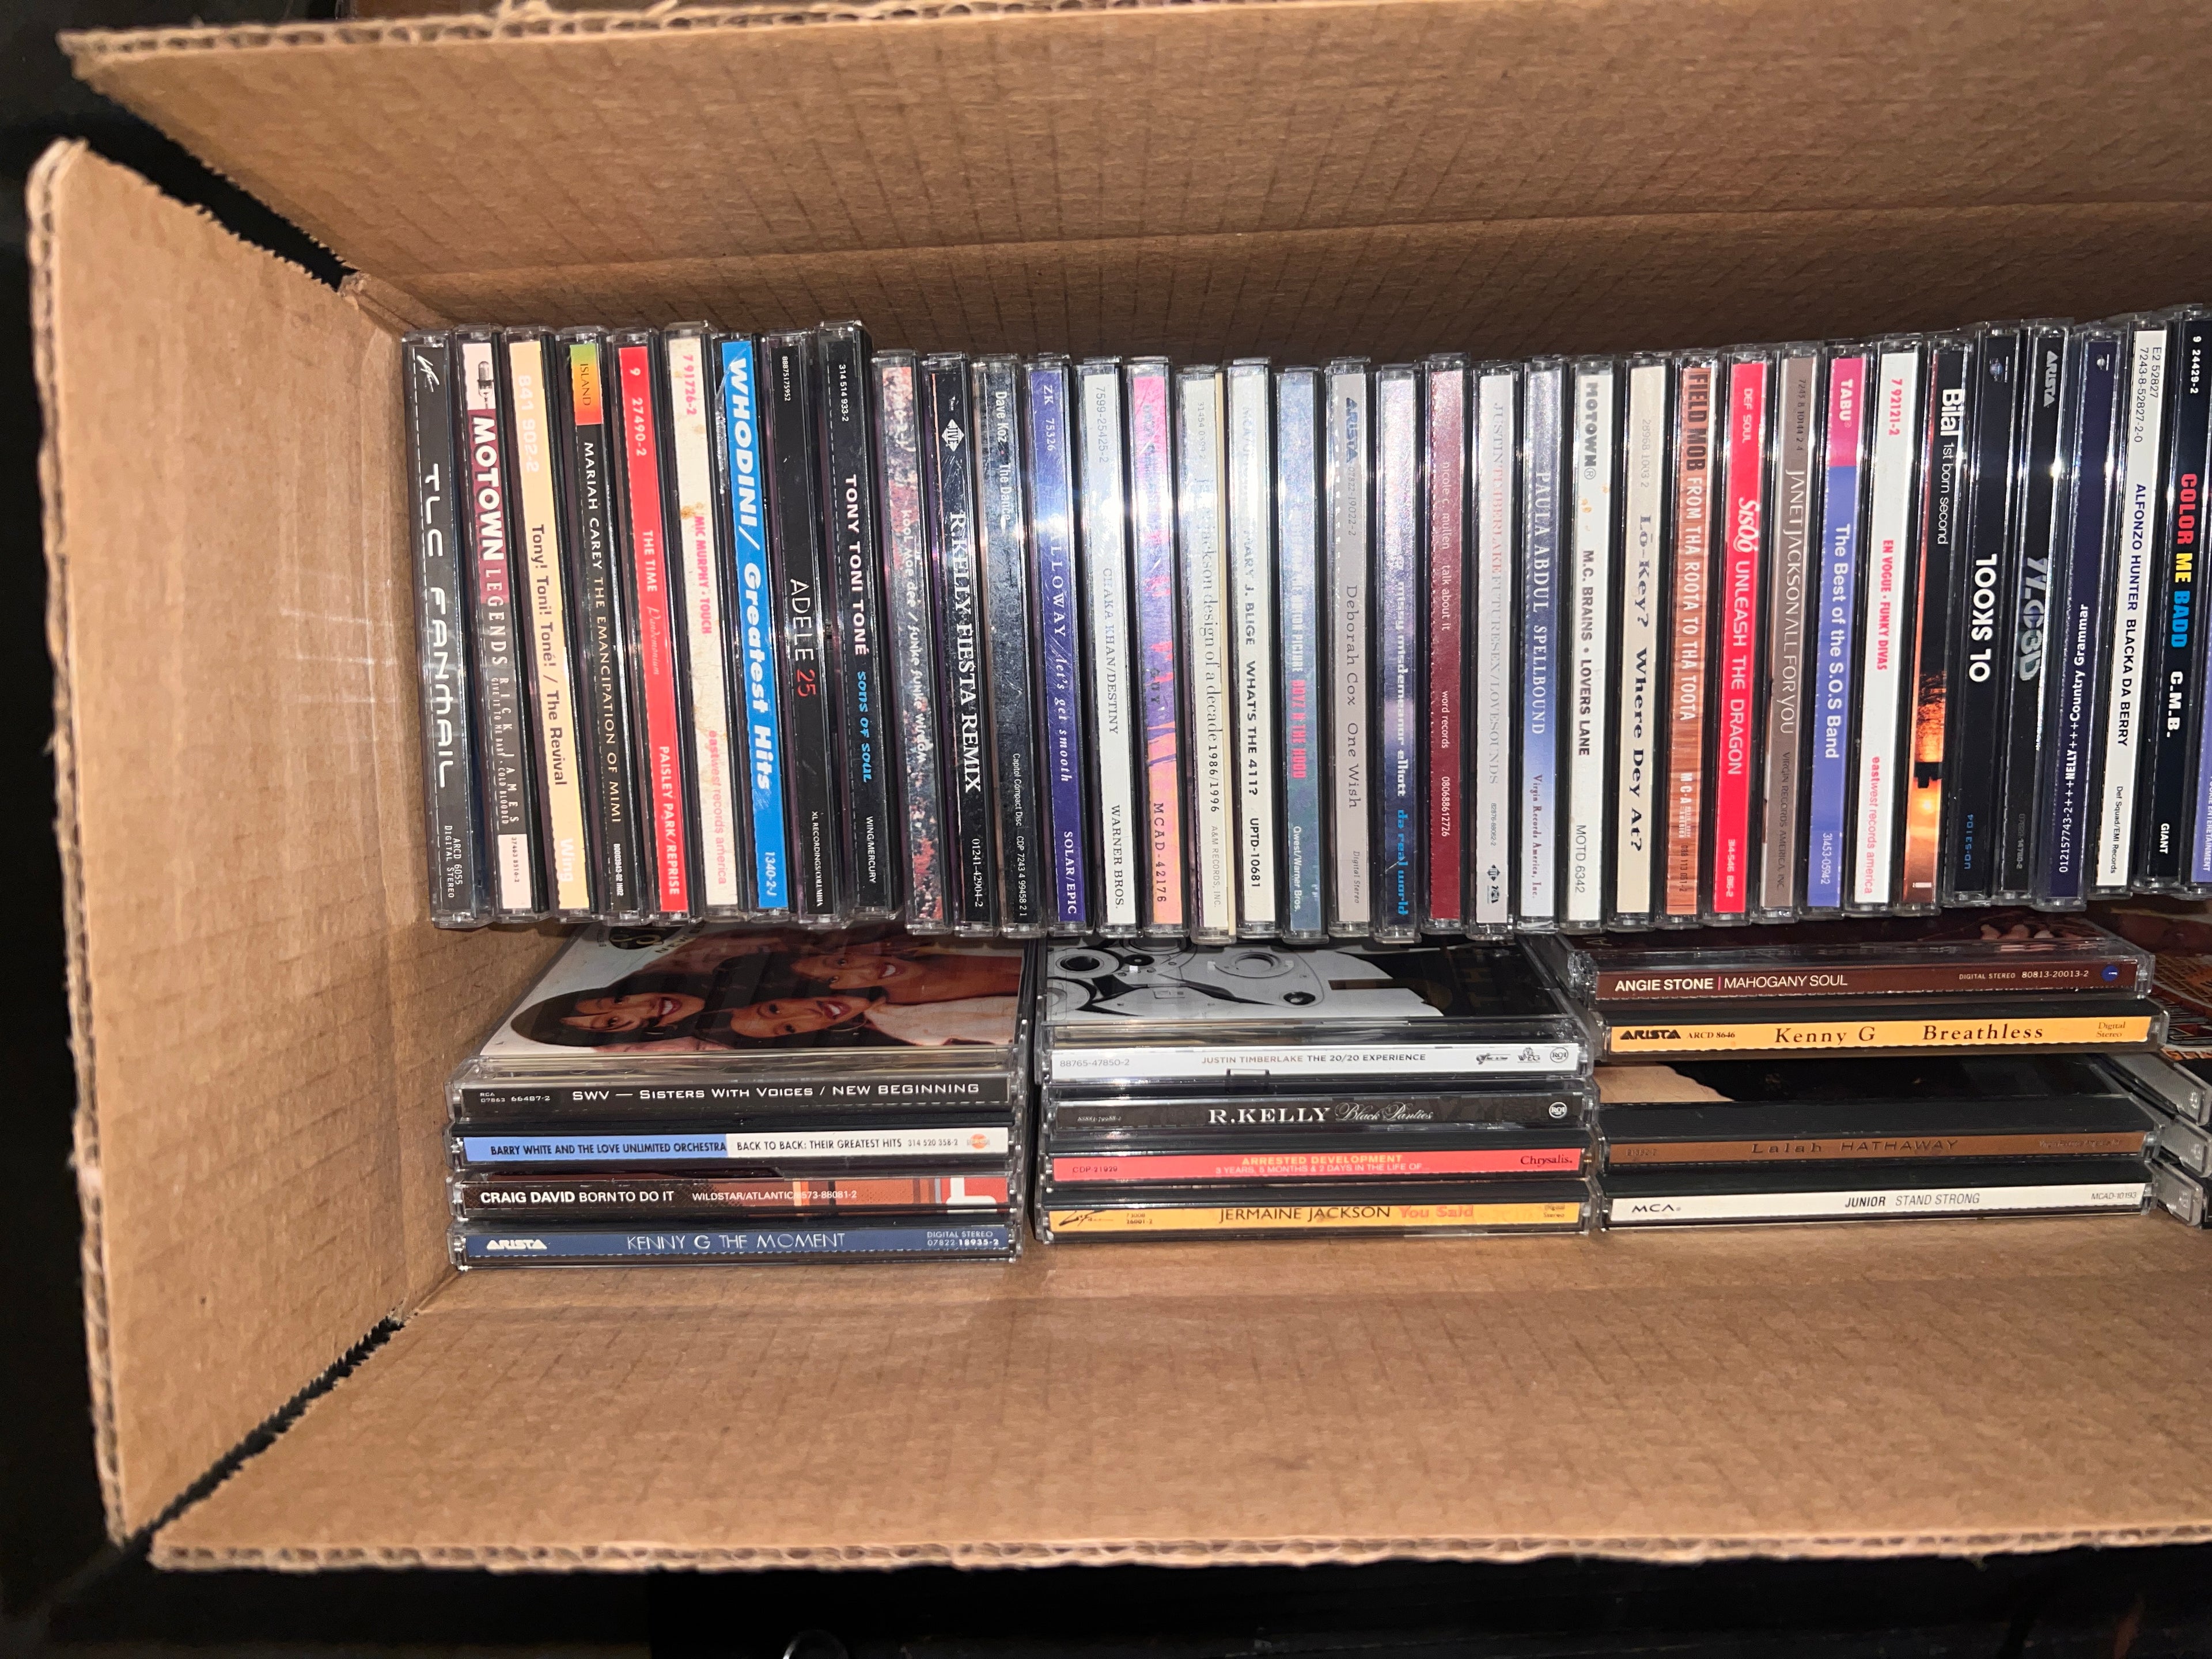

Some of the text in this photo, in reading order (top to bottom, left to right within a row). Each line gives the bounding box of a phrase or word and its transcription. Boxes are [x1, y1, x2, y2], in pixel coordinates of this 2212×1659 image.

[839, 364, 847, 380] 314
[2043, 350, 2058, 408] ARISTA
[2153, 347, 2162, 362] E2
[518, 375, 533, 411] 841
[579, 363, 592, 406] ISLAND
[684, 365, 696, 415] 91726-2
[1043, 385, 1053, 405] ZK
[1889, 388, 1902, 436] 92121-2
[2134, 347, 2149, 443] 7243-8-52827-2-0
[632, 397, 647, 457] 27490-2
[995, 391, 1011, 483] Dave Koz The
[1095, 386, 1108, 463] 7599-25425-2
[1346, 397, 1358, 465] ARISTA
[1742, 388, 1753, 444] DEF SOUL
[1937, 388, 1964, 545] Bilal born second
[472, 417, 508, 665] MOTOWN LEGENDS
[1679, 373, 1708, 721] FIELD MOB FROM THA ROOTA THA TOOTA
[1883, 539, 1894, 554] EN
[695, 516, 713, 634] MIC MURPHY TOUCH
[1532, 471, 1551, 734] PAULA ABDUL SPELLBOUND
[425, 464, 454, 787] TLC FANMAIL
[583, 442, 622, 823] MARIAH CAREY THE EMANCIPATION OF MIMI
[790, 578, 814, 661] ADELE
[1395, 581, 1406, 630] missy
[2117, 483, 2146, 747] ALFONZO HUNTER BLACKA DA BERRY
[531, 524, 564, 785] Tony! Toni! The Revival
[1291, 634, 1303, 672] PICTURE
[1441, 565, 1451, 748] talk about word records
[1825, 524, 1851, 758] The Best the Band
[2073, 604, 2088, 666] Grammar
[745, 562, 774, 790] Greatest Hits
[845, 475, 877, 883] TONY TONI WING/MERCURY
[1149, 667, 1161, 705] GUY
[1244, 603, 1257, 753] BLIGE THE
[1728, 560, 1749, 775] UNLEASH DRAGON
[1782, 656, 1797, 694] FOR
[2159, 474, 2198, 854] COLOR ME BADD GIANT
[642, 531, 680, 895] THE TIME PAISLEY PARK/REPRISE
[956, 623, 981, 793] FIESTA REMIX
[1206, 685, 1223, 741] decade
[1346, 585, 1361, 809] Deborah Cox One Wish
[1633, 647, 1647, 738] Where
[498, 767, 506, 785] COLD
[1012, 753, 1022, 778] Capitol
[1575, 660, 1592, 893] LOVERS LANE MOTD 6342
[1781, 752, 1791, 783] VIRGIN
[1016, 836, 1025, 851] CDP
[1111, 804, 1123, 865] WARNER
[2111, 786, 2123, 874] Def Records
[453, 838, 463, 884] ARCD 6055
[559, 838, 575, 882] Wing
[1063, 831, 1077, 914] SOLAR/EPIC
[1615, 974, 1848, 992] ANGIE STONE MAHOGANY SOUL
[1774, 1024, 2044, 1045] Kenny Breathless
[2096, 1030, 2122, 1038] Stereo
[2098, 1021, 2126, 1030] Digital
[1202, 1053, 1426, 1065] JUSTIN TIMBERLAKE THE EXPERIENCE
[572, 1090, 609, 1101] SWV
[1207, 1108, 1331, 1124] R.KELLY
[491, 1138, 902, 1156] BARRY WHITE AND THE LOVE UNLIMITED ORCHESTRA BACK TO THEIR GREATEST HITS
[1242, 1154, 1402, 1165] ARRESTED DEVELOPMENT
[1751, 1142, 1823, 1154] Lalah
[480, 1191, 575, 1204] CRAIG DAVID
[1219, 1208, 1302, 1224] JERMAINE
[1845, 1194, 1932, 1208] JUNIOR STAND
[627, 1233, 845, 1251] KENNY G THE MOMENT
[927, 1238, 999, 1246] 07822-18935-2
